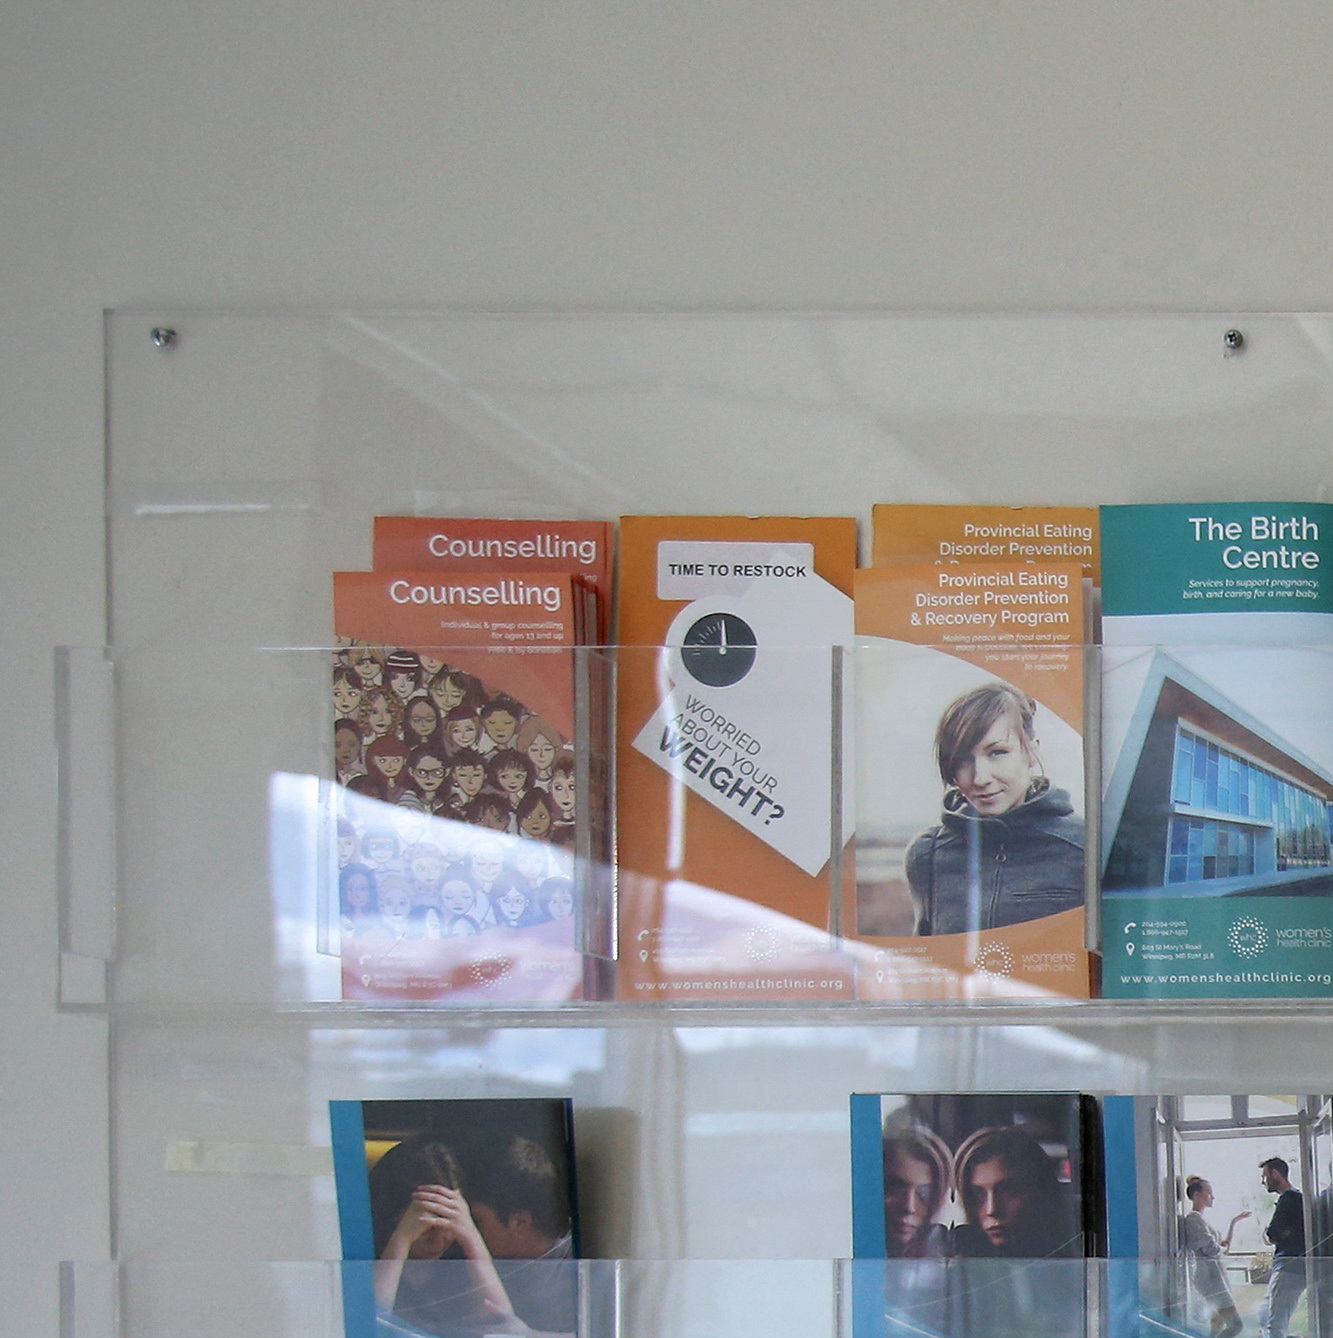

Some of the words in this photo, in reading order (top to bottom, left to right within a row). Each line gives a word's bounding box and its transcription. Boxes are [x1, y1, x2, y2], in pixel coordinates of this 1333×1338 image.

[964, 524, 1040, 538] Provincial
[1044, 524, 1093, 541] Eating
[1188, 517, 1242, 541] The
[1251, 516, 1319, 541] Birth
[429, 534, 597, 564] Counselling
[940, 542, 1006, 556] Disorder
[1009, 542, 1093, 556] Prevention
[1222, 545, 1320, 570] Centre
[669, 564, 704, 576] TIME
[708, 564, 729, 576] TO
[733, 565, 807, 578] RESTOCK
[939, 572, 1015, 587] Provincial
[1018, 572, 1068, 588] Eating
[1188, 579, 1224, 588] Services
[1225, 579, 1235, 588] to
[1236, 579, 1270, 591] support
[390, 580, 561, 611] Counselling
[916, 593, 980, 607] Disorder
[984, 591, 1069, 606] Prevention
[1206, 590, 1223, 598] and
[1224, 590, 1252, 600] caring
[1253, 589, 1266, 600] for
[1275, 590, 1294, 598] new
[910, 613, 922, 626] &
[926, 611, 997, 627] Recovery
[1002, 611, 1070, 627] Program
[685, 694, 761, 756] WORRIED
[671, 713, 731, 758] ABOUT
[731, 750, 778, 794] YOUR
[659, 725, 785, 825] WEIGHT?
[1120, 972, 1332, 985] www.womenshealthclinic.org
